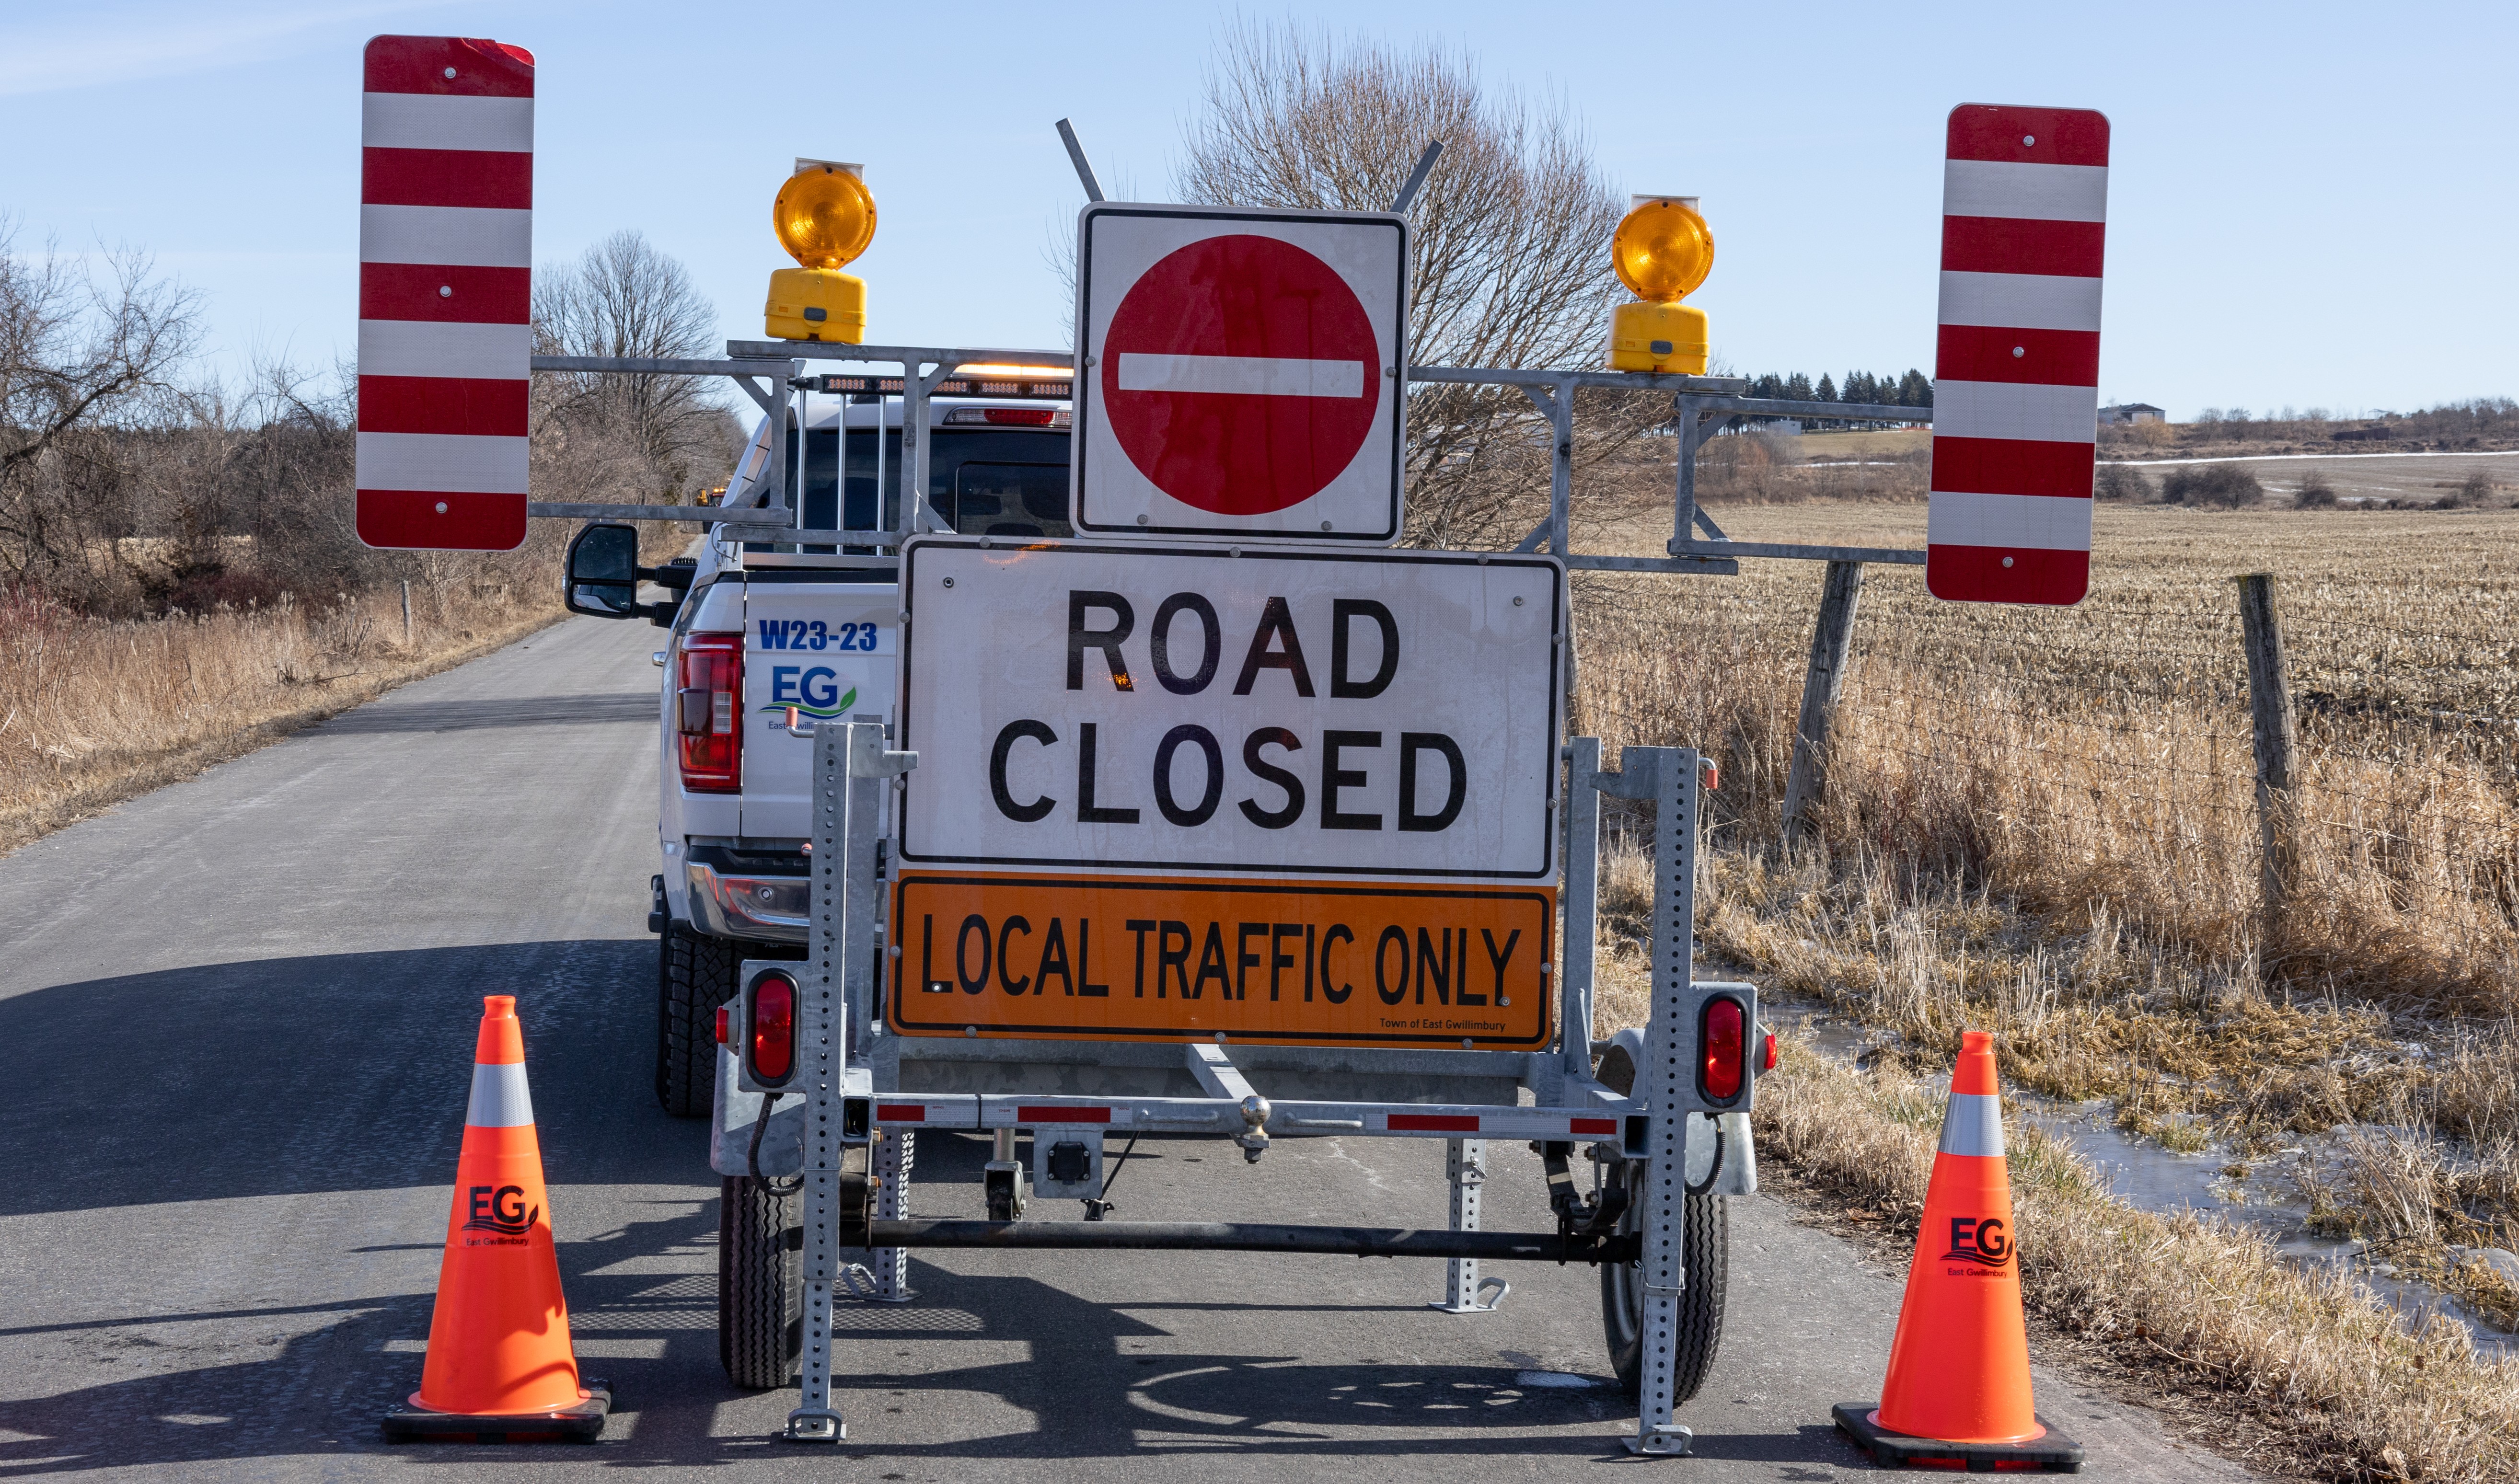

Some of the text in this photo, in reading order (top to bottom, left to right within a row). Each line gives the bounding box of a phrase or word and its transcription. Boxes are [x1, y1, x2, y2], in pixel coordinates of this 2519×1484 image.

[759, 620, 877, 652] W23-23
[1066, 590, 1399, 699] ROAD
[772, 666, 838, 708] EG
[768, 721, 786, 729] East
[989, 719, 1467, 832] CLOSED
[922, 914, 1522, 1007] LOCAL TRAFFIC ONLY
[1380, 1018, 1506, 1032] Town of East Gwillimbury
[470, 1185, 526, 1224] EG
[466, 1237, 529, 1246] East Gwillimbury
[1951, 1218, 2005, 1256] EG
[1966, 1268, 2007, 1278] Gwillimbury
